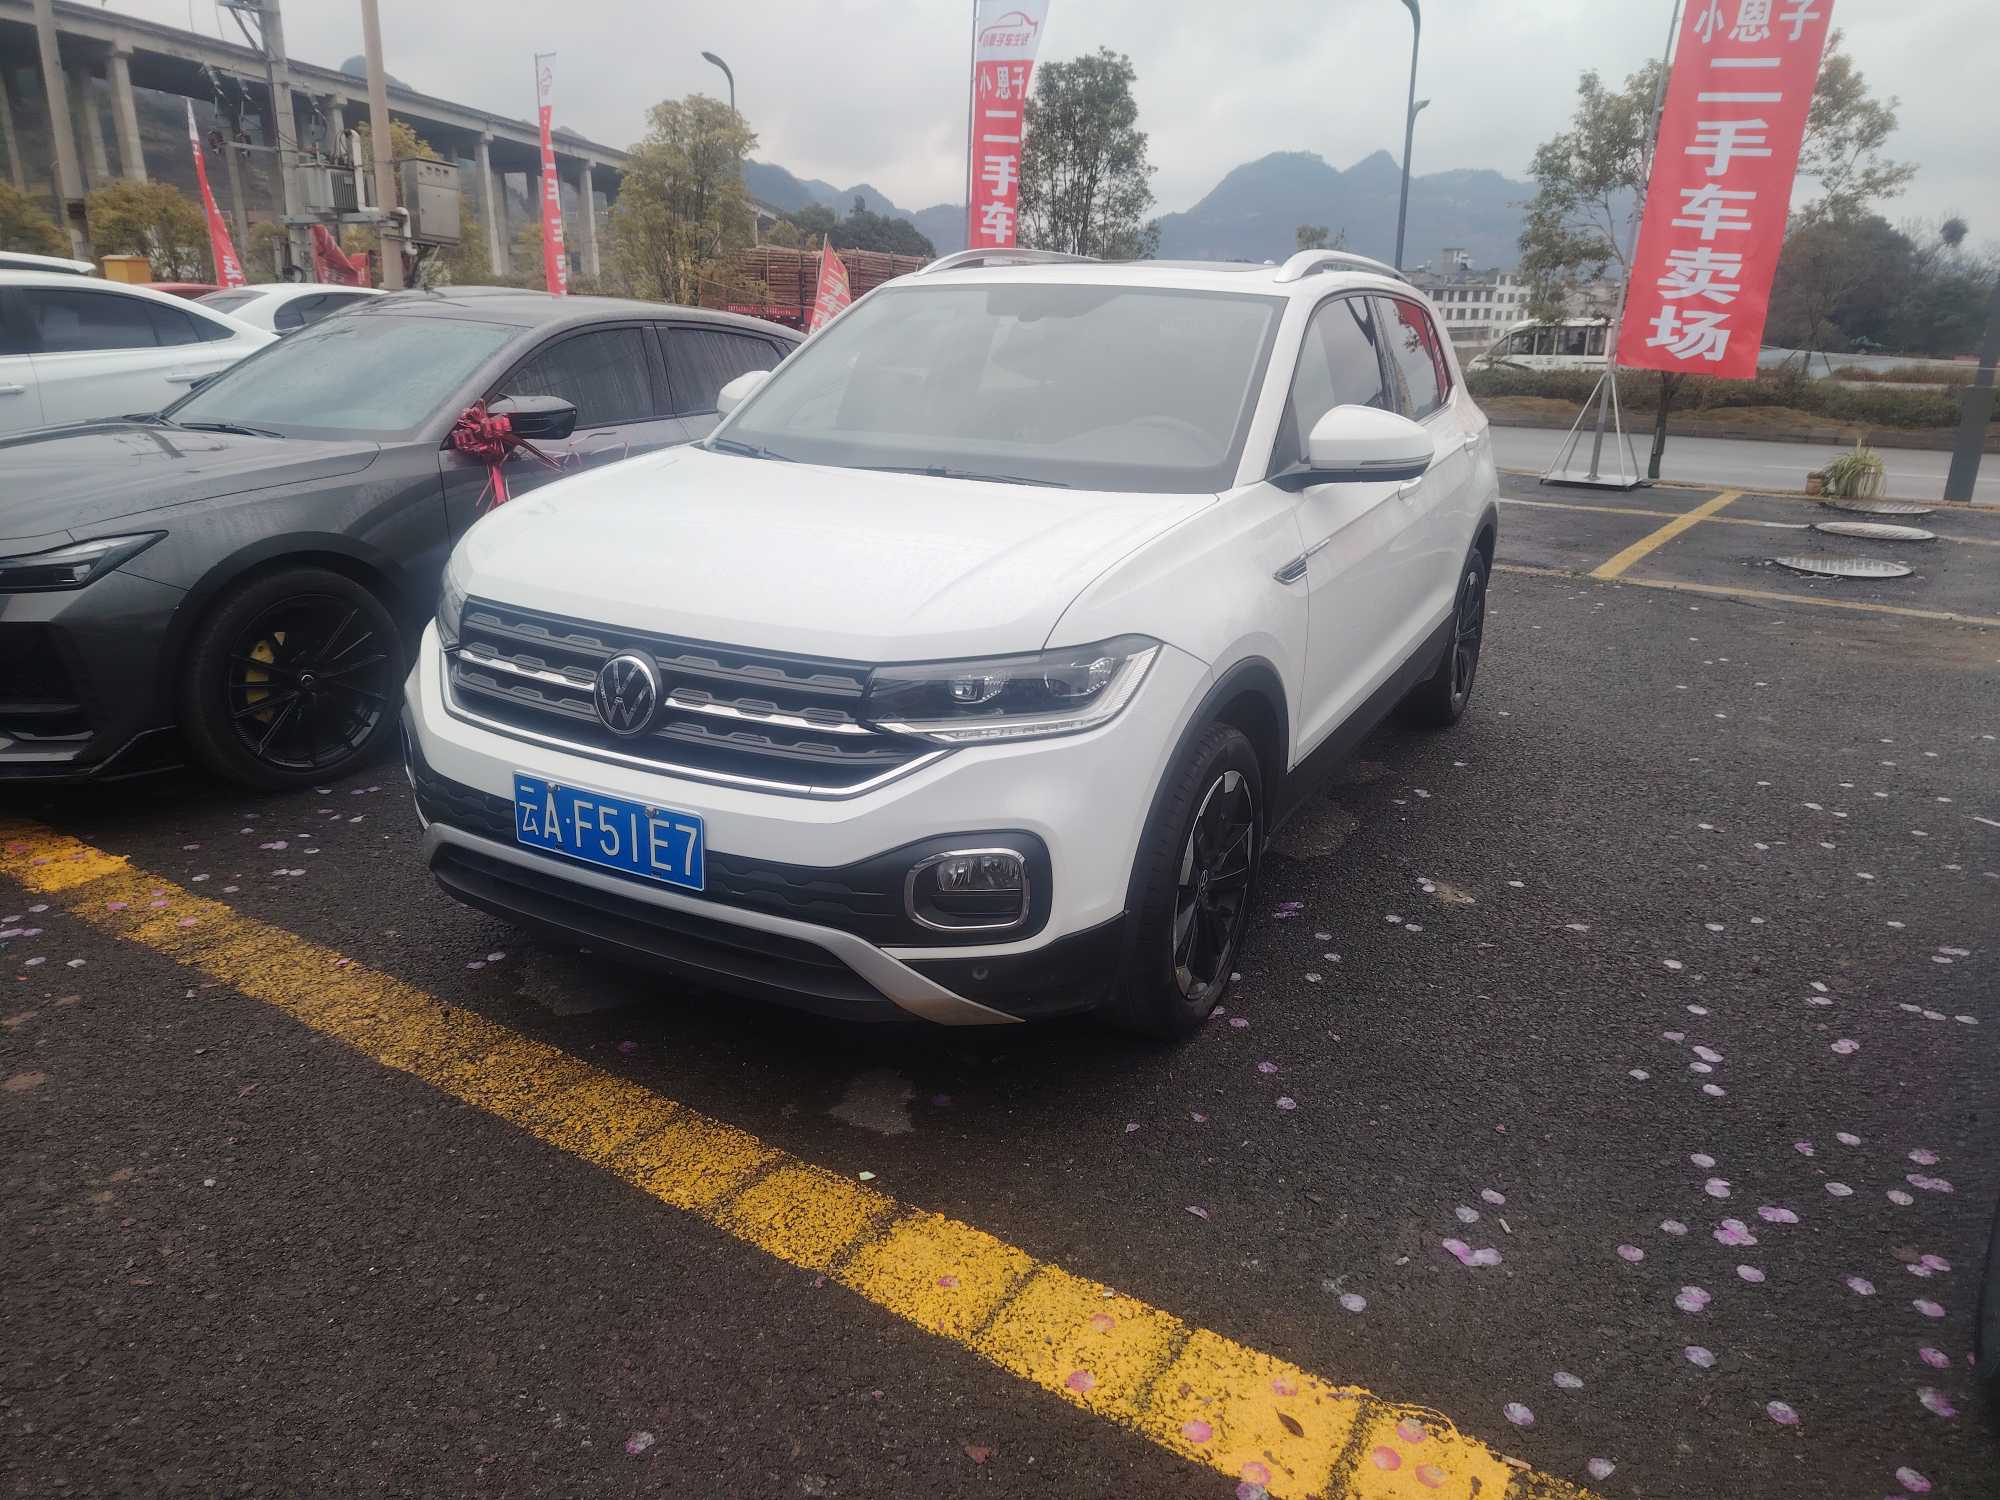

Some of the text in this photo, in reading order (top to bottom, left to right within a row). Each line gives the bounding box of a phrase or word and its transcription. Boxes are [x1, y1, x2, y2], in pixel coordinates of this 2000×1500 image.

[1694, 0, 1821, 43] 小恩子
[980, 66, 1024, 99] 小恩子
[980, 110, 1019, 244] 二手车
[1646, 57, 1782, 361] 二手车卖场
